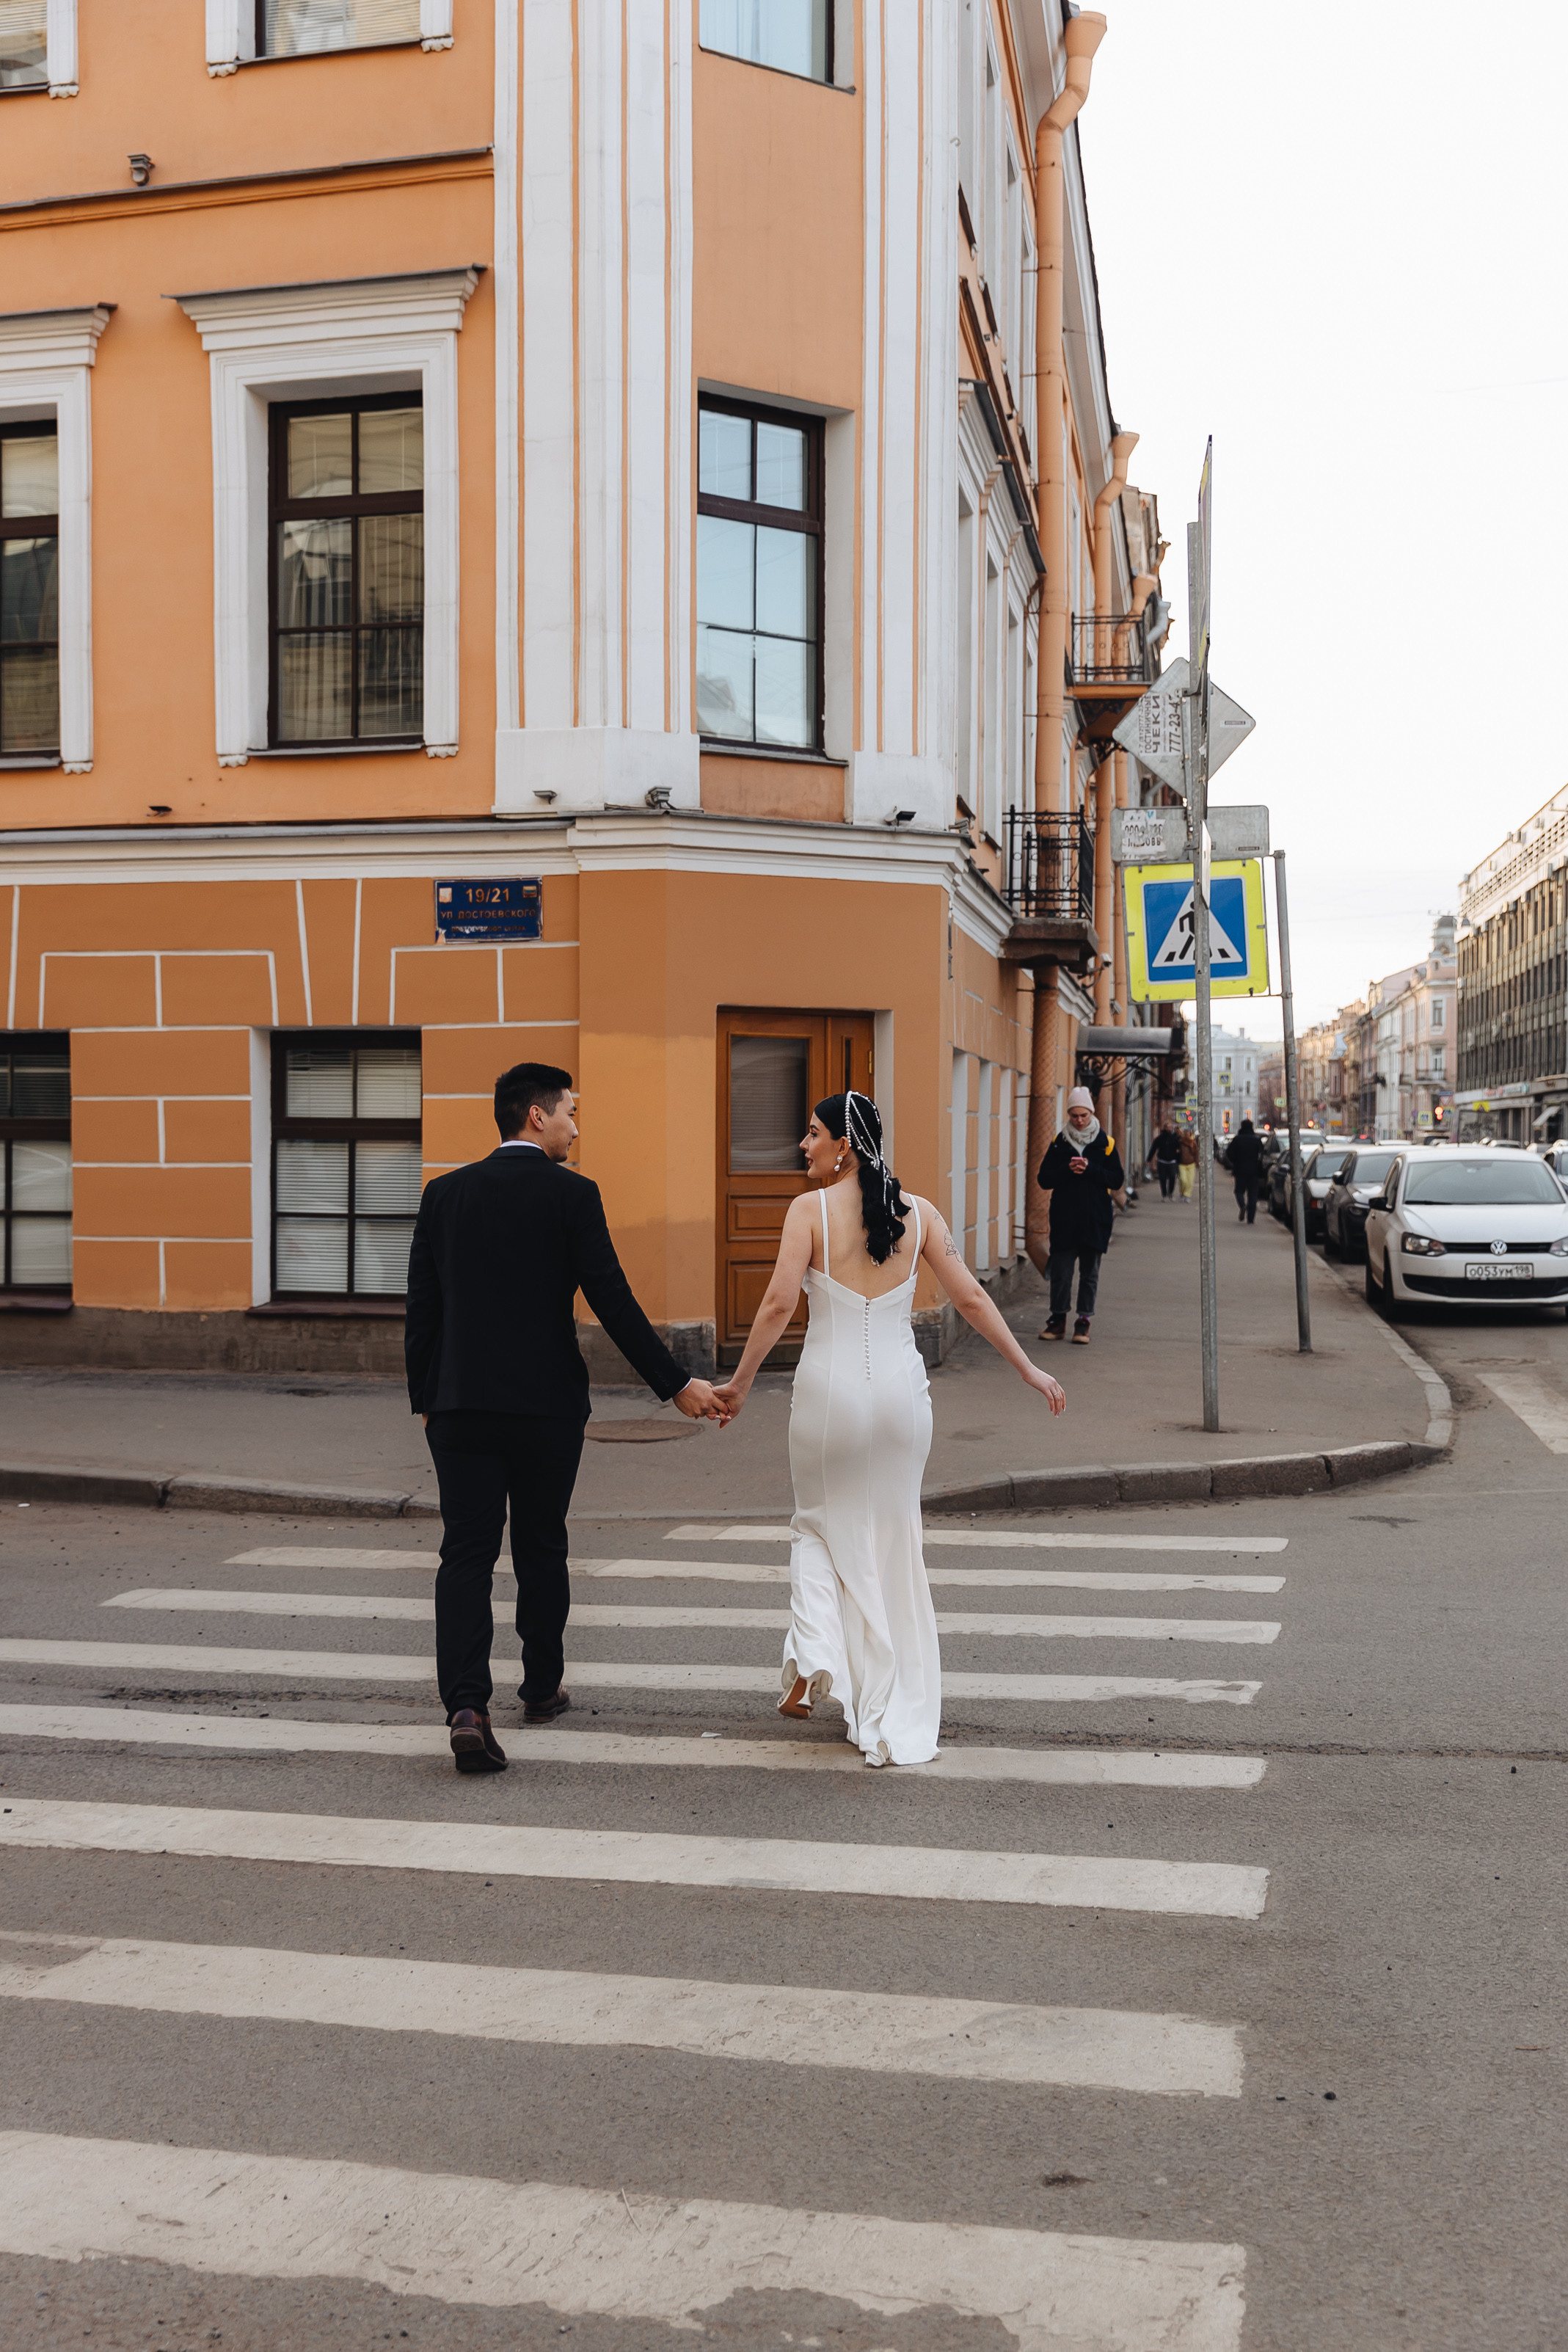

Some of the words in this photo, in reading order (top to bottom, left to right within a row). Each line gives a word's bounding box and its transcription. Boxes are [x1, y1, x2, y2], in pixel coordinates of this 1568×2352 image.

[1152, 695, 1160, 753] ЧЕКИ
[466, 887, 509, 903] 19/21
[458, 909, 536, 920] ДОСТОЕВСКОГО
